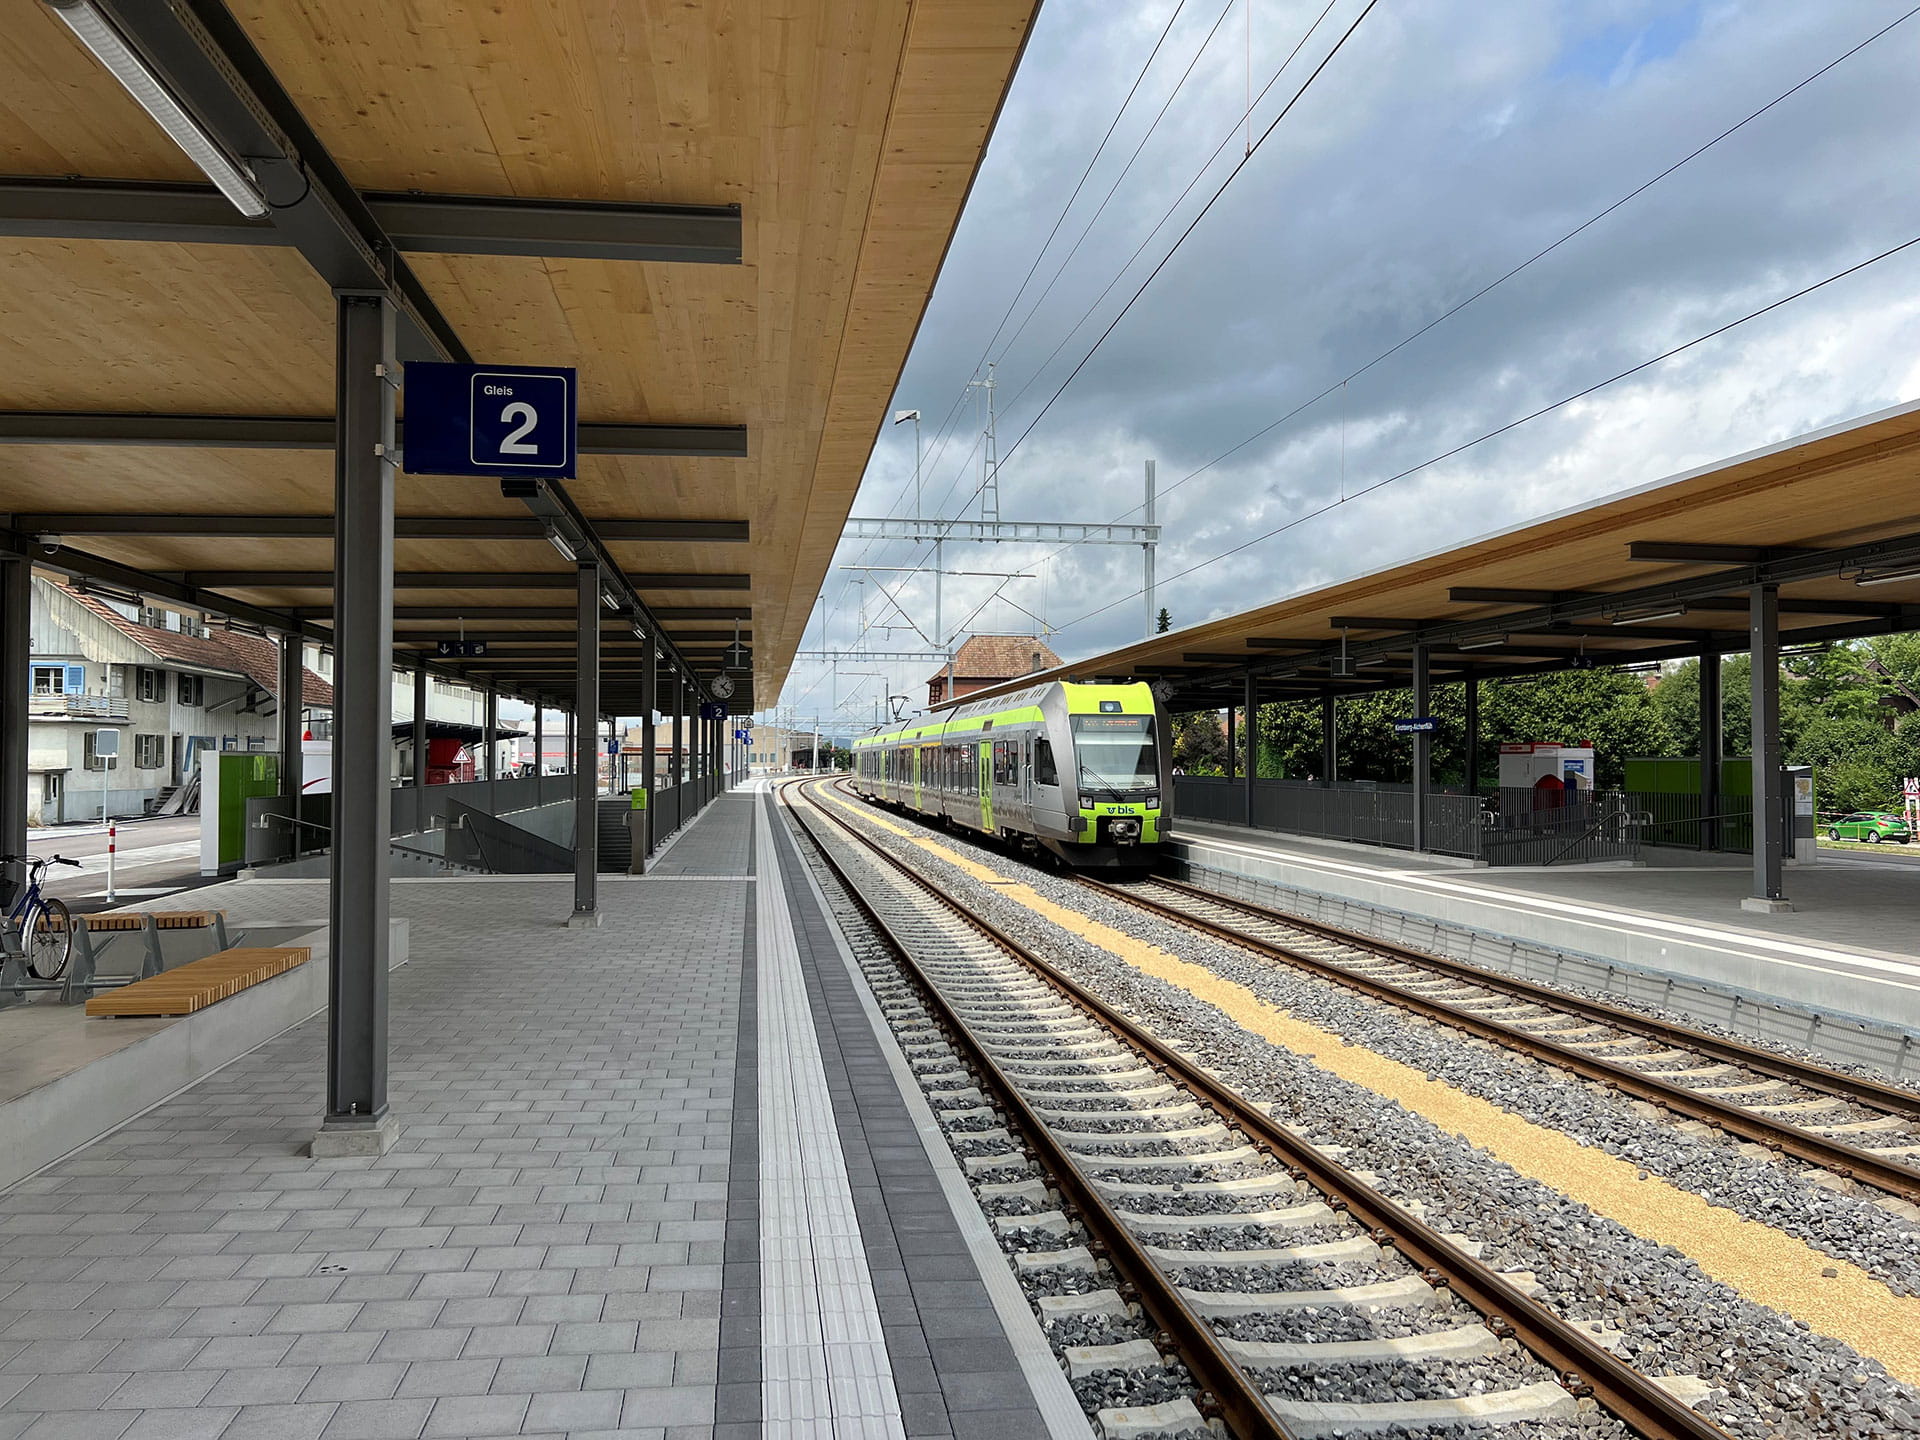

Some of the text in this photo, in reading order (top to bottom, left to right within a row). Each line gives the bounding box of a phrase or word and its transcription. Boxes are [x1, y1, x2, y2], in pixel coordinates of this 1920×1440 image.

[484, 386, 513, 396] Gleis
[499, 402, 538, 455] 2
[715, 707, 722, 717] 2
[1117, 805, 1135, 814] bls
